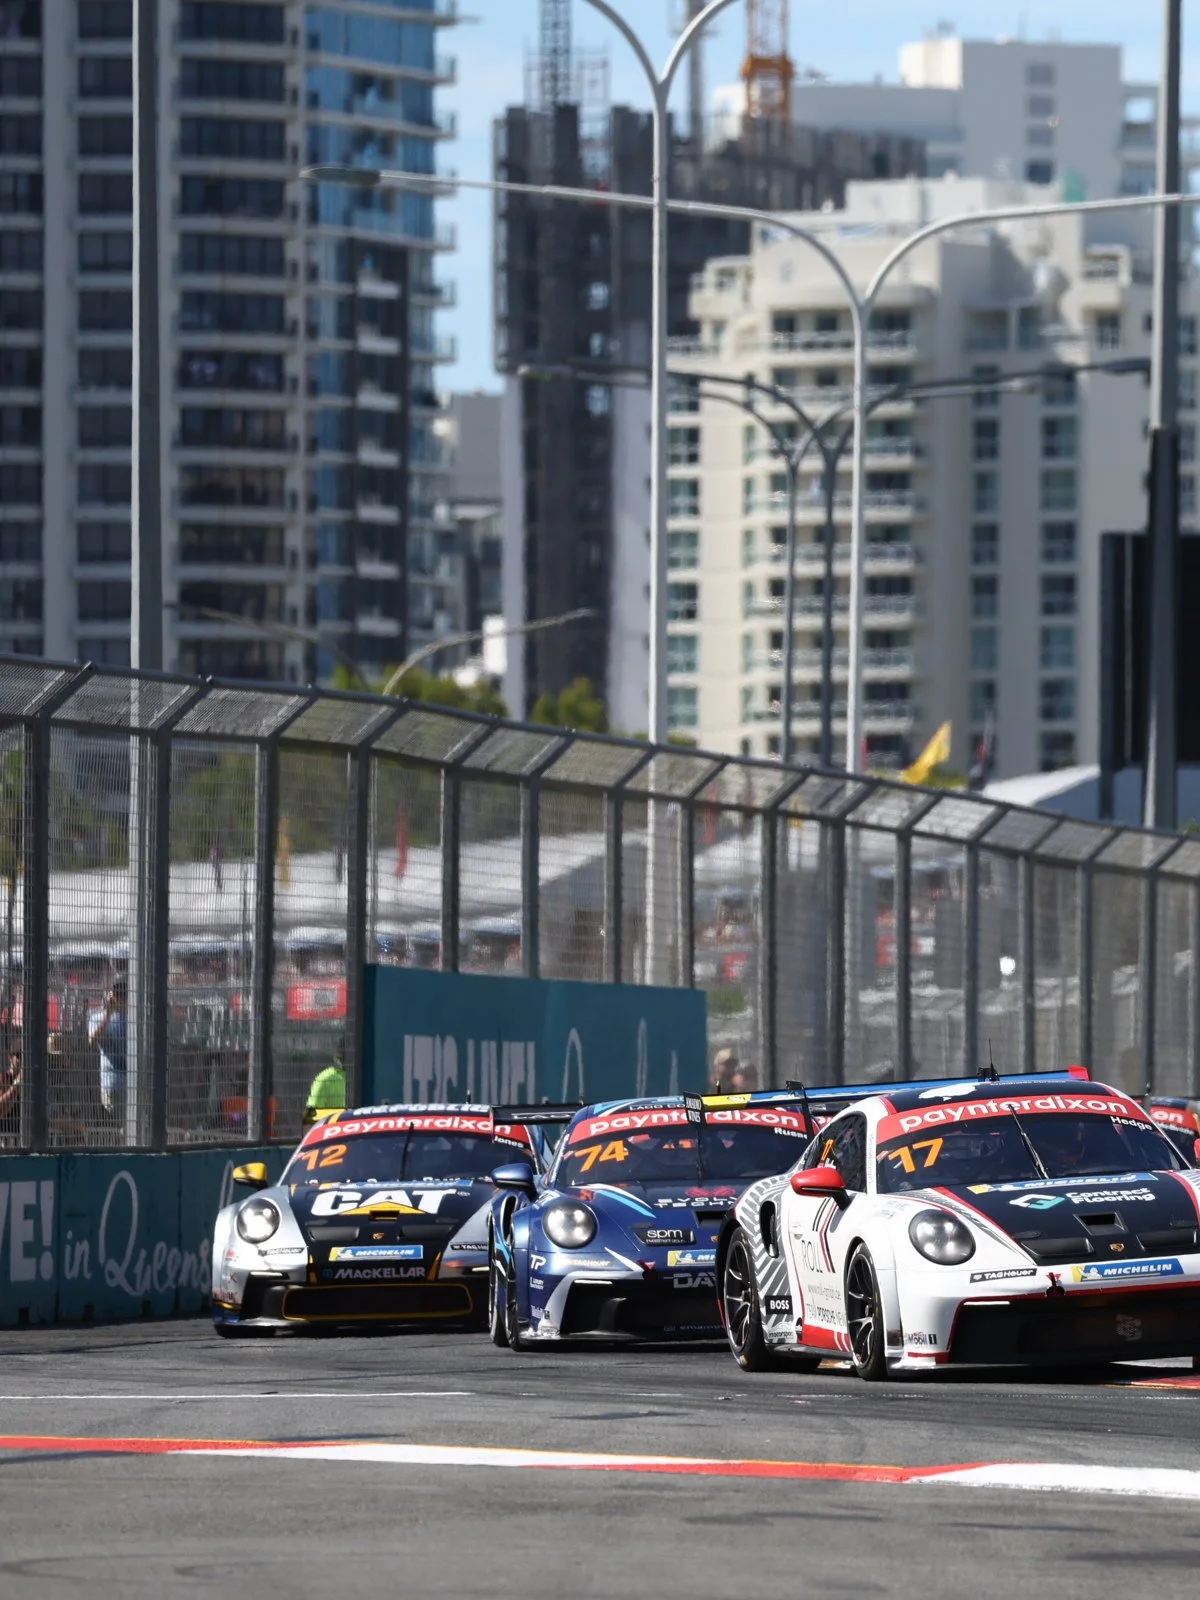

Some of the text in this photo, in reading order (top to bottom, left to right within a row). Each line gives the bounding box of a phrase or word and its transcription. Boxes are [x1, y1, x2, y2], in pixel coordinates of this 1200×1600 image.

[900, 1096, 1128, 1132] paynterdixon
[323, 1116, 511, 1140] paynterdixon
[1110, 1115, 1152, 1131] Hedge
[302, 1144, 349, 1171] 12
[575, 1140, 629, 1172] 74
[888, 1137, 944, 1174] 17
[1024, 1175, 1137, 1188] MICHELIN
[1066, 1187, 1151, 1198] Contract
[1070, 1192, 1156, 1205] Flooring
[311, 1189, 457, 1216] CAT
[646, 1229, 683, 1239] spm
[64, 1230, 91, 1280] in
[334, 1267, 426, 1280] MACKELLAR
[983, 1269, 1034, 1280] TAGHeuer
[1102, 1263, 1173, 1276] MICHELIN
[770, 1299, 790, 1310] BOSS
